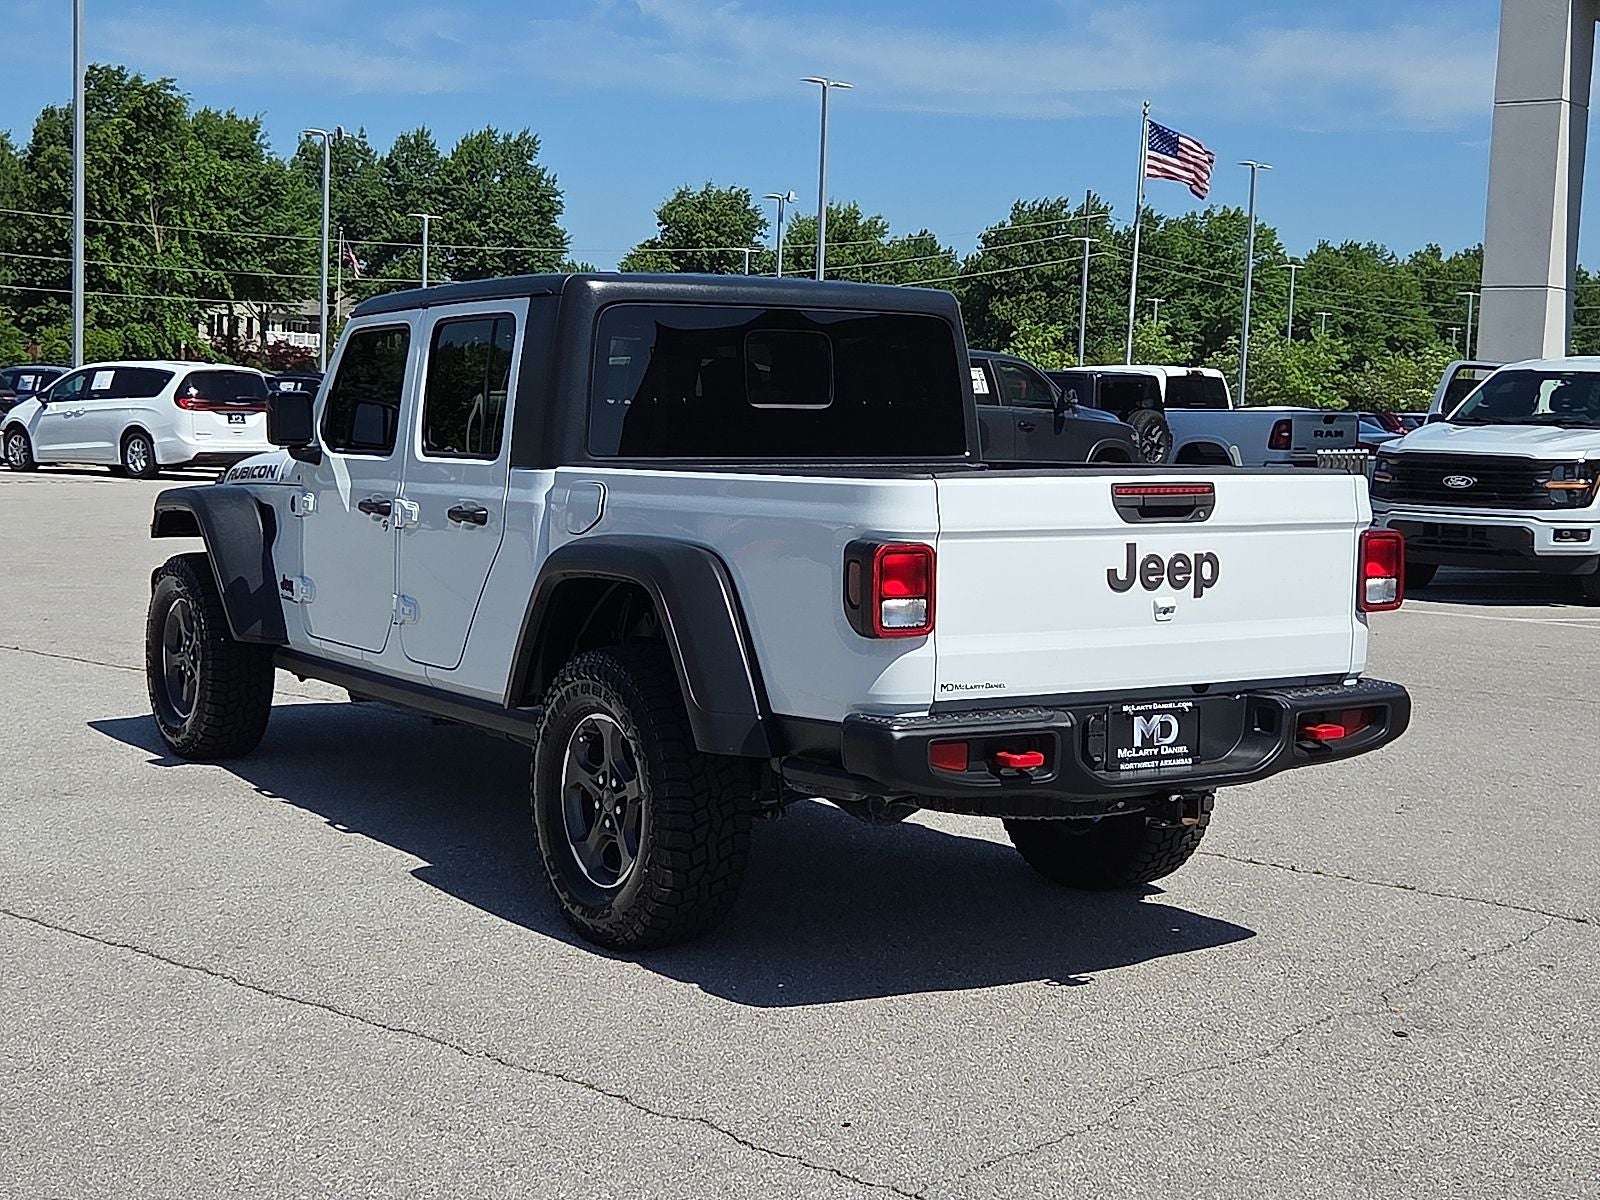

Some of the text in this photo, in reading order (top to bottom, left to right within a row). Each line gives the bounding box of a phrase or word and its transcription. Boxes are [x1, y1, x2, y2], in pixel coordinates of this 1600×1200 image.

[1313, 430, 1344, 438] RAM
[227, 464, 279, 482] RUBICON
[1106, 542, 1220, 599] Jeep
[1133, 713, 1179, 747] MD
[1159, 757, 1193, 767] ARKANSAS
